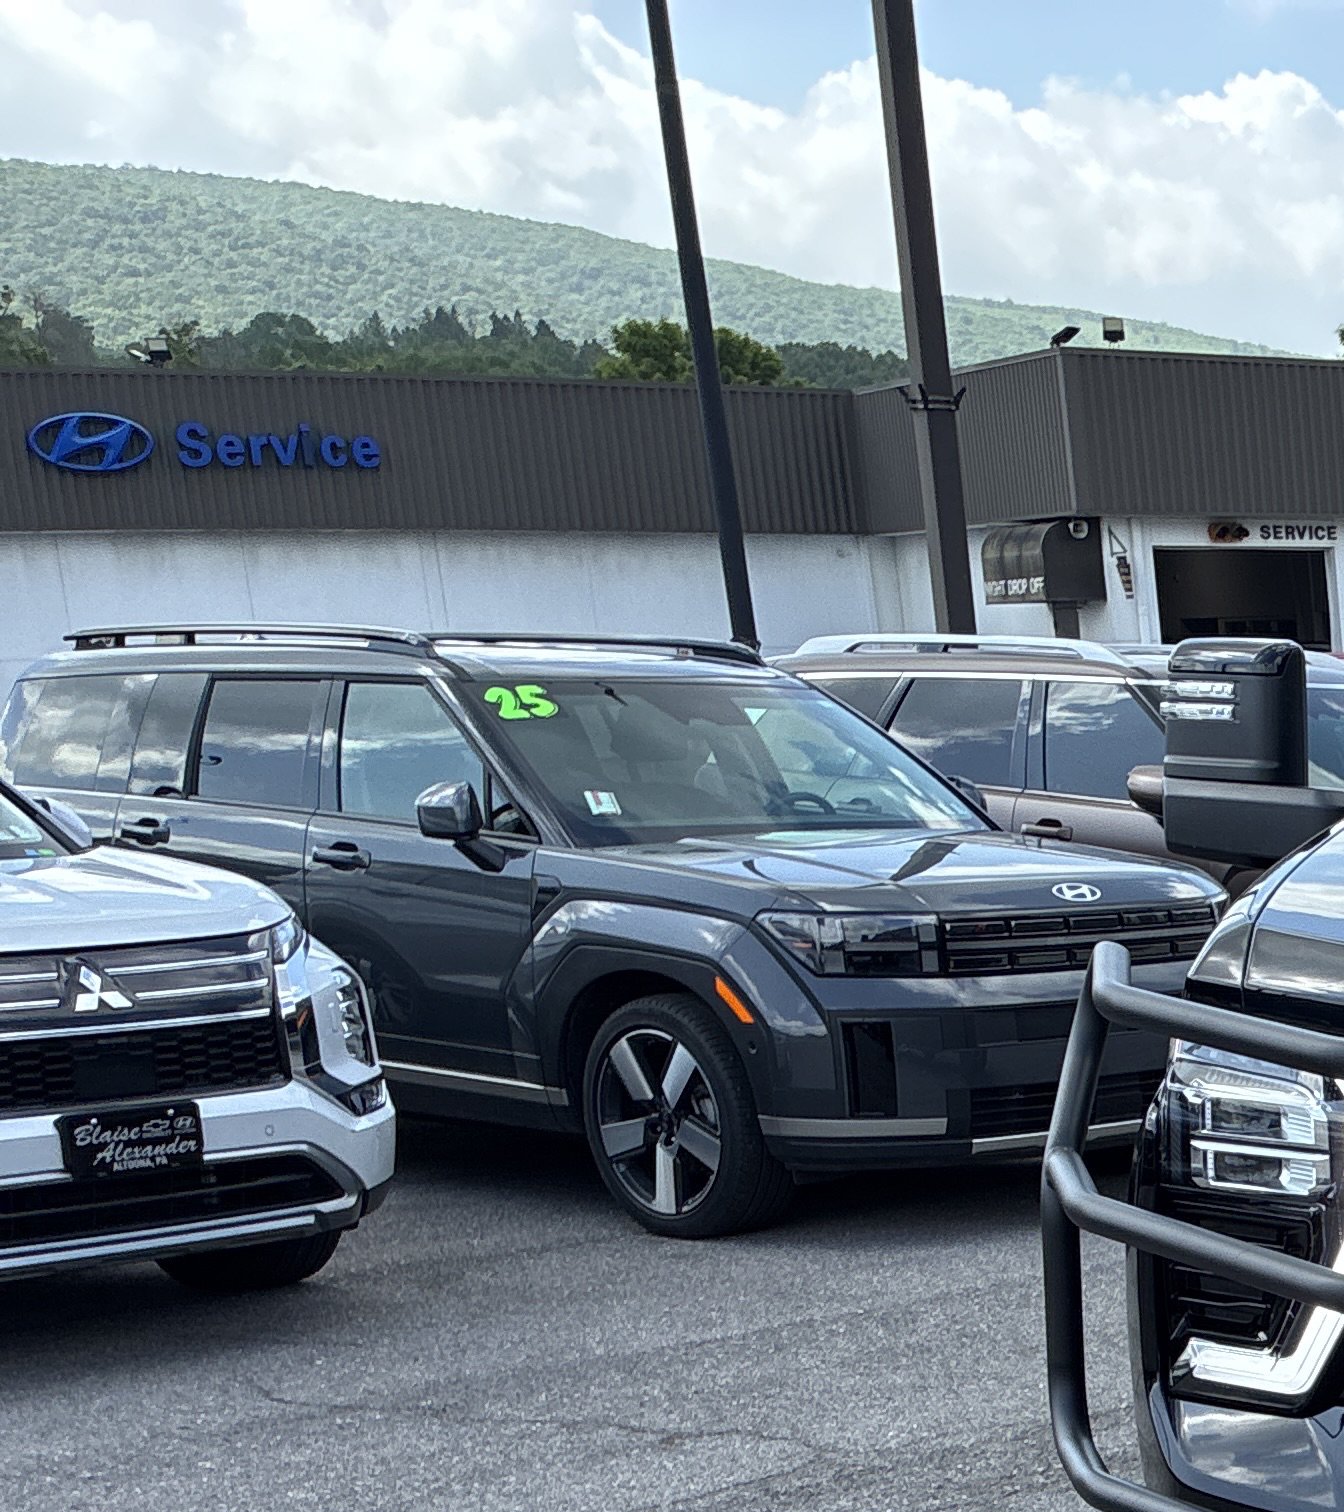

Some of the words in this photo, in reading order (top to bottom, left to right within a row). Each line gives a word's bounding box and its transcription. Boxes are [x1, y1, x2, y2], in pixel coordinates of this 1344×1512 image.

[175, 421, 381, 469] Service
[1259, 525, 1338, 541] SERVICE
[1007, 577, 1028, 596] DROP
[1029, 576, 1045, 595] OFF
[484, 684, 559, 720] 25
[73, 1123, 142, 1147] Blaise
[92, 1135, 199, 1167] Alexander
